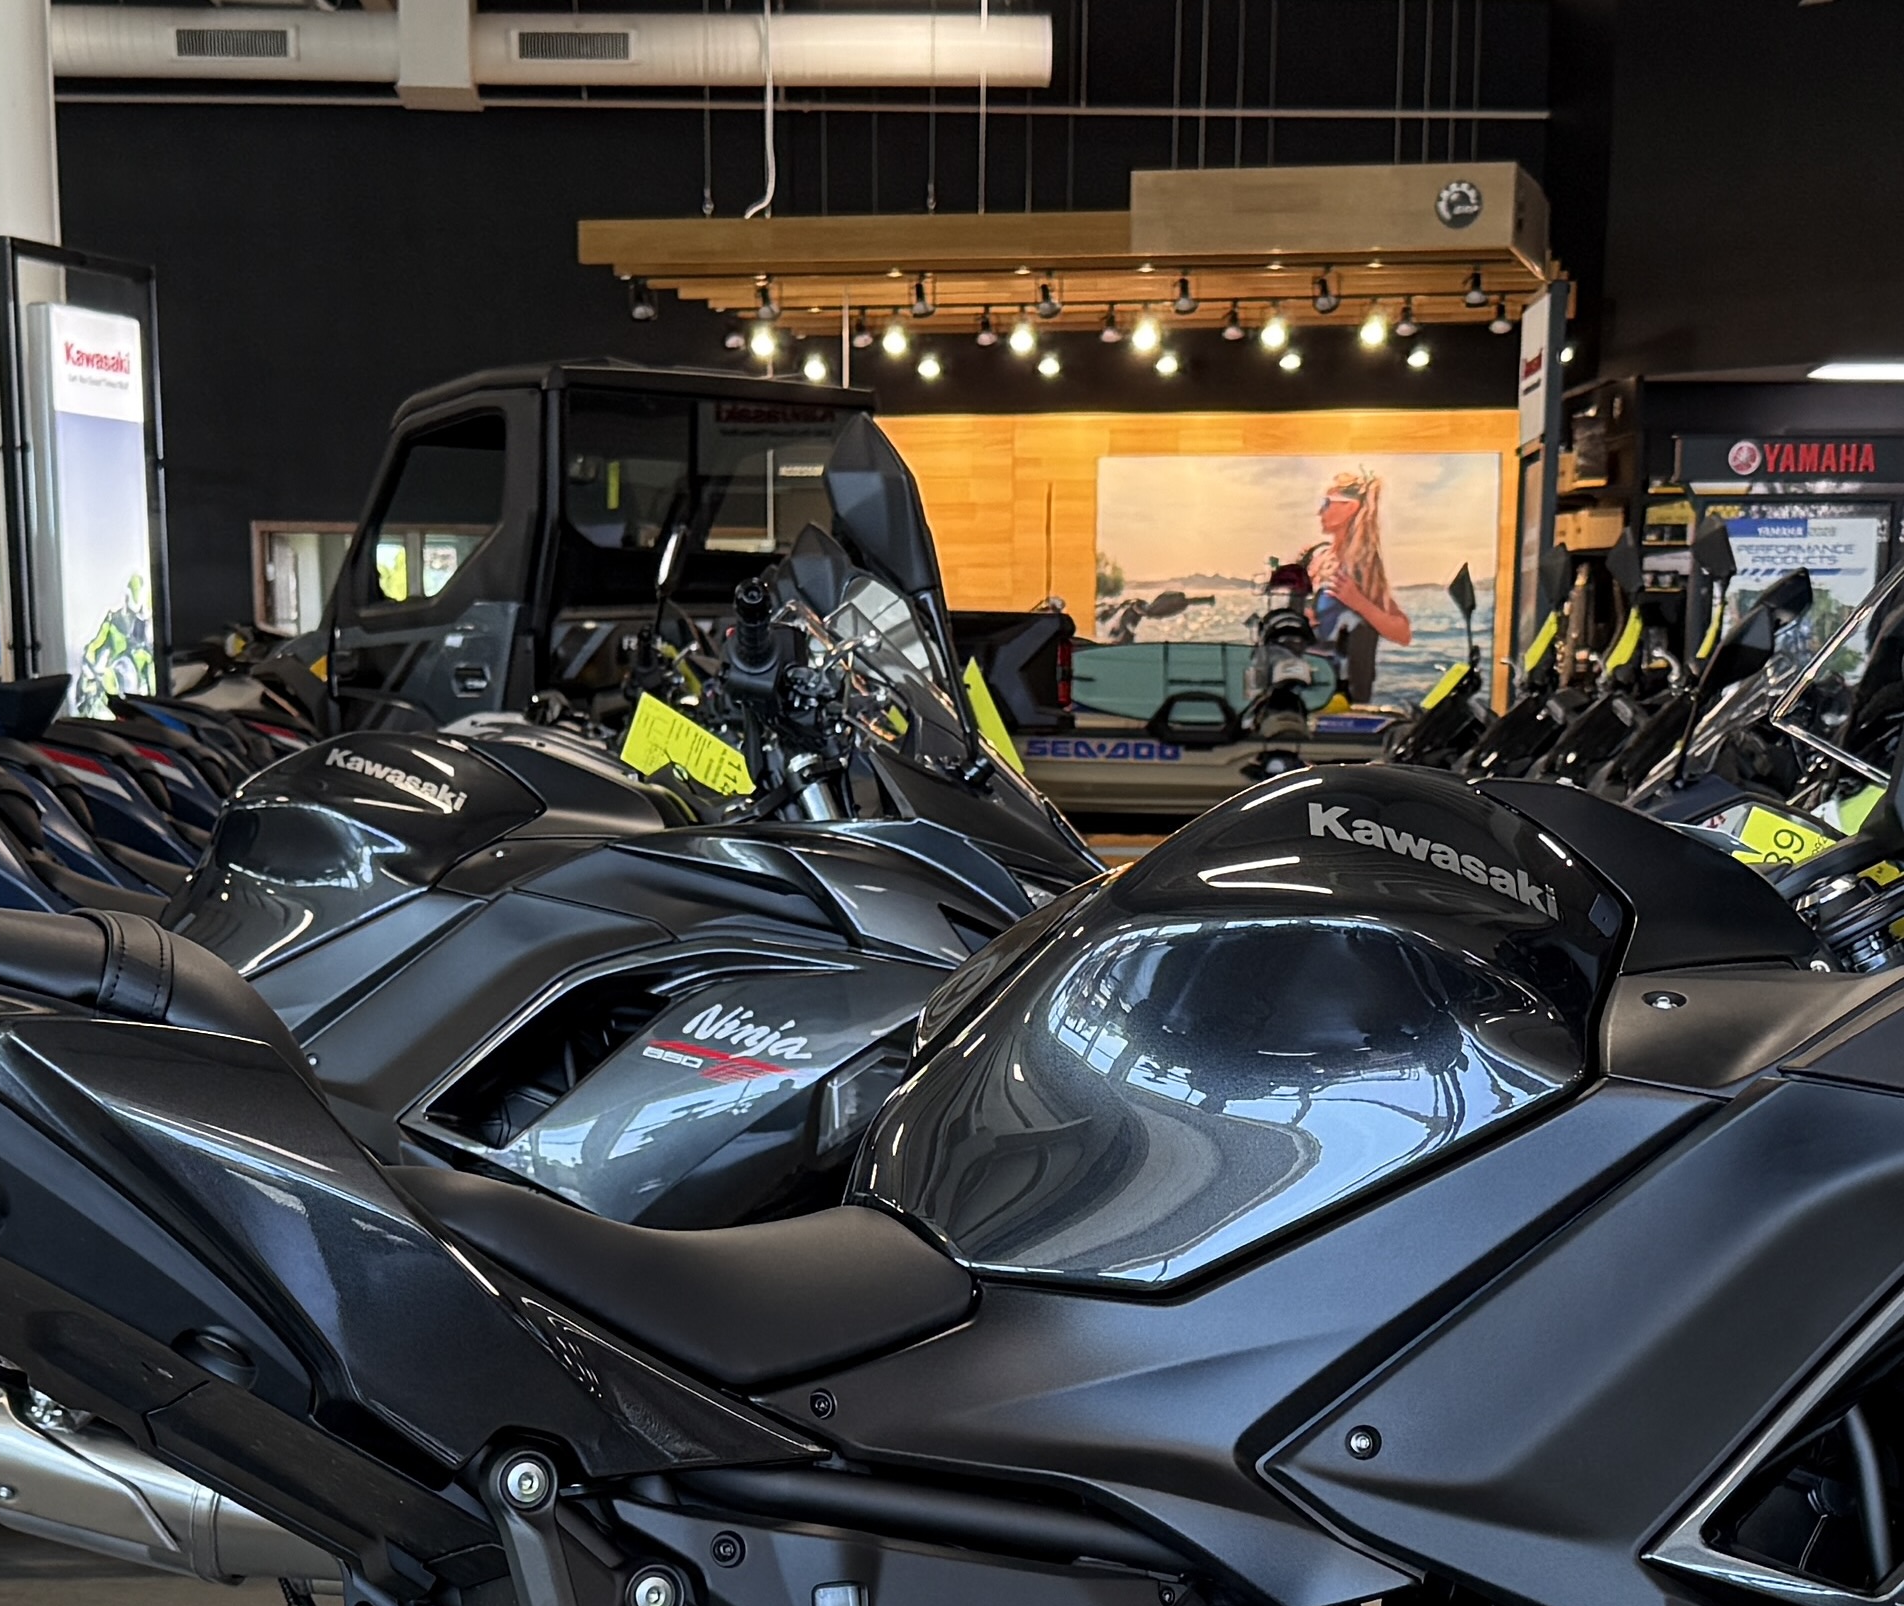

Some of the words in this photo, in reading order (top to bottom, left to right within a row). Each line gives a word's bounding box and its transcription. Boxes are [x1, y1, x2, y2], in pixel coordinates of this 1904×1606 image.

[64, 341, 130, 374] Kawasaki
[1763, 443, 1876, 473] YAMAHA
[1735, 544, 1856, 556] PERFORMANCE
[1750, 554, 1838, 566] PRODUCTS
[324, 746, 466, 814] Kawasaki
[1308, 801, 1559, 920] Kawasaki
[681, 1002, 813, 1063] Ninja
[641, 1045, 704, 1070] 650
